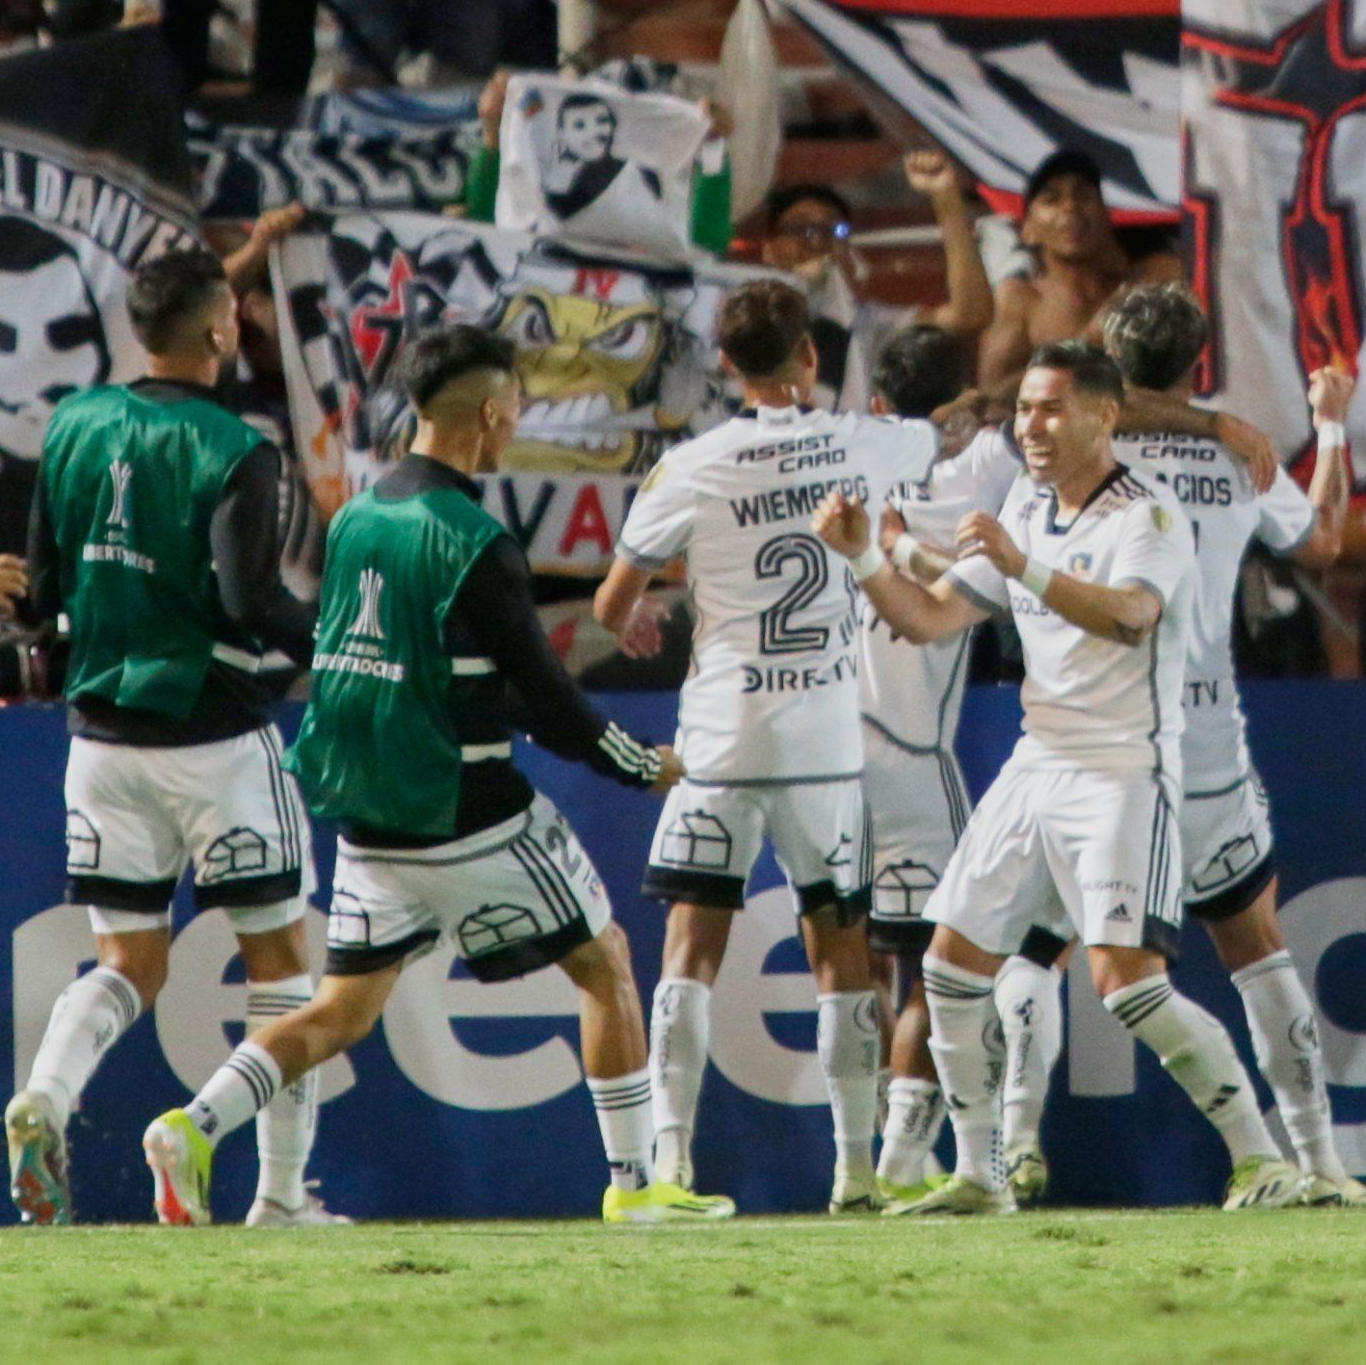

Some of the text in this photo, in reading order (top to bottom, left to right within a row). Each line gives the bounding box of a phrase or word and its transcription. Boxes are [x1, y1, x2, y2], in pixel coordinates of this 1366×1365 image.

[737, 435, 833, 465] ASSIST
[778, 448, 846, 473] CARD
[1140, 445, 1217, 462] CARD
[754, 533, 830, 655] 2
